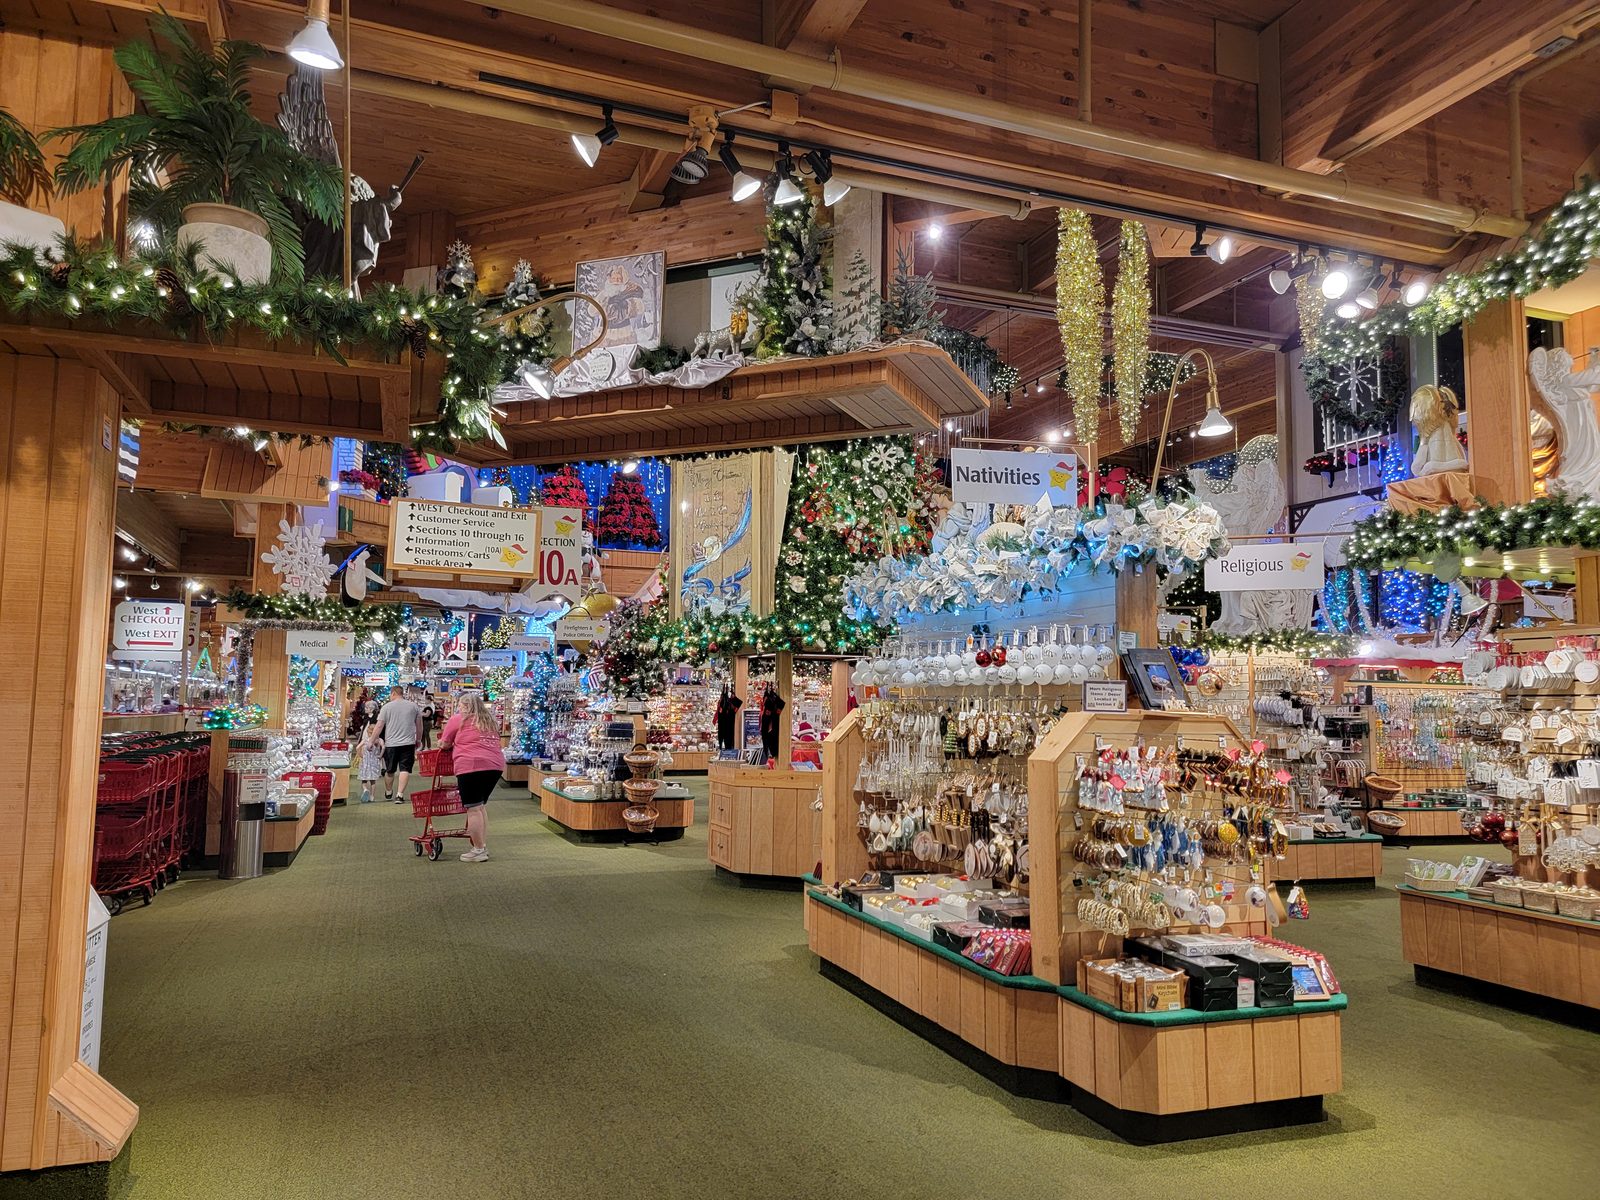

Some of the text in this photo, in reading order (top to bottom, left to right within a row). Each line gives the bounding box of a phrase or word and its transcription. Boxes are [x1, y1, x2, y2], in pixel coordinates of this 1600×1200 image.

[956, 466, 1040, 486] Nativities
[418, 503, 527, 520] WEST Checkout and Exit
[416, 514, 495, 528] Customer Service
[416, 526, 457, 536] Sections
[473, 530, 511, 542] through
[515, 534, 524, 542] 16
[416, 536, 470, 548] Information
[414, 547, 490, 560] Restrooms/Carts
[485, 546, 502, 554] (10A)
[414, 557, 441, 566] Snack
[538, 550, 578, 585] 10A
[1220, 559, 1284, 576] Religious
[133, 606, 158, 614] West
[120, 615, 182, 625] CHECKOUT
[125, 630, 150, 638] West
[86, 931, 101, 951] ITTER
